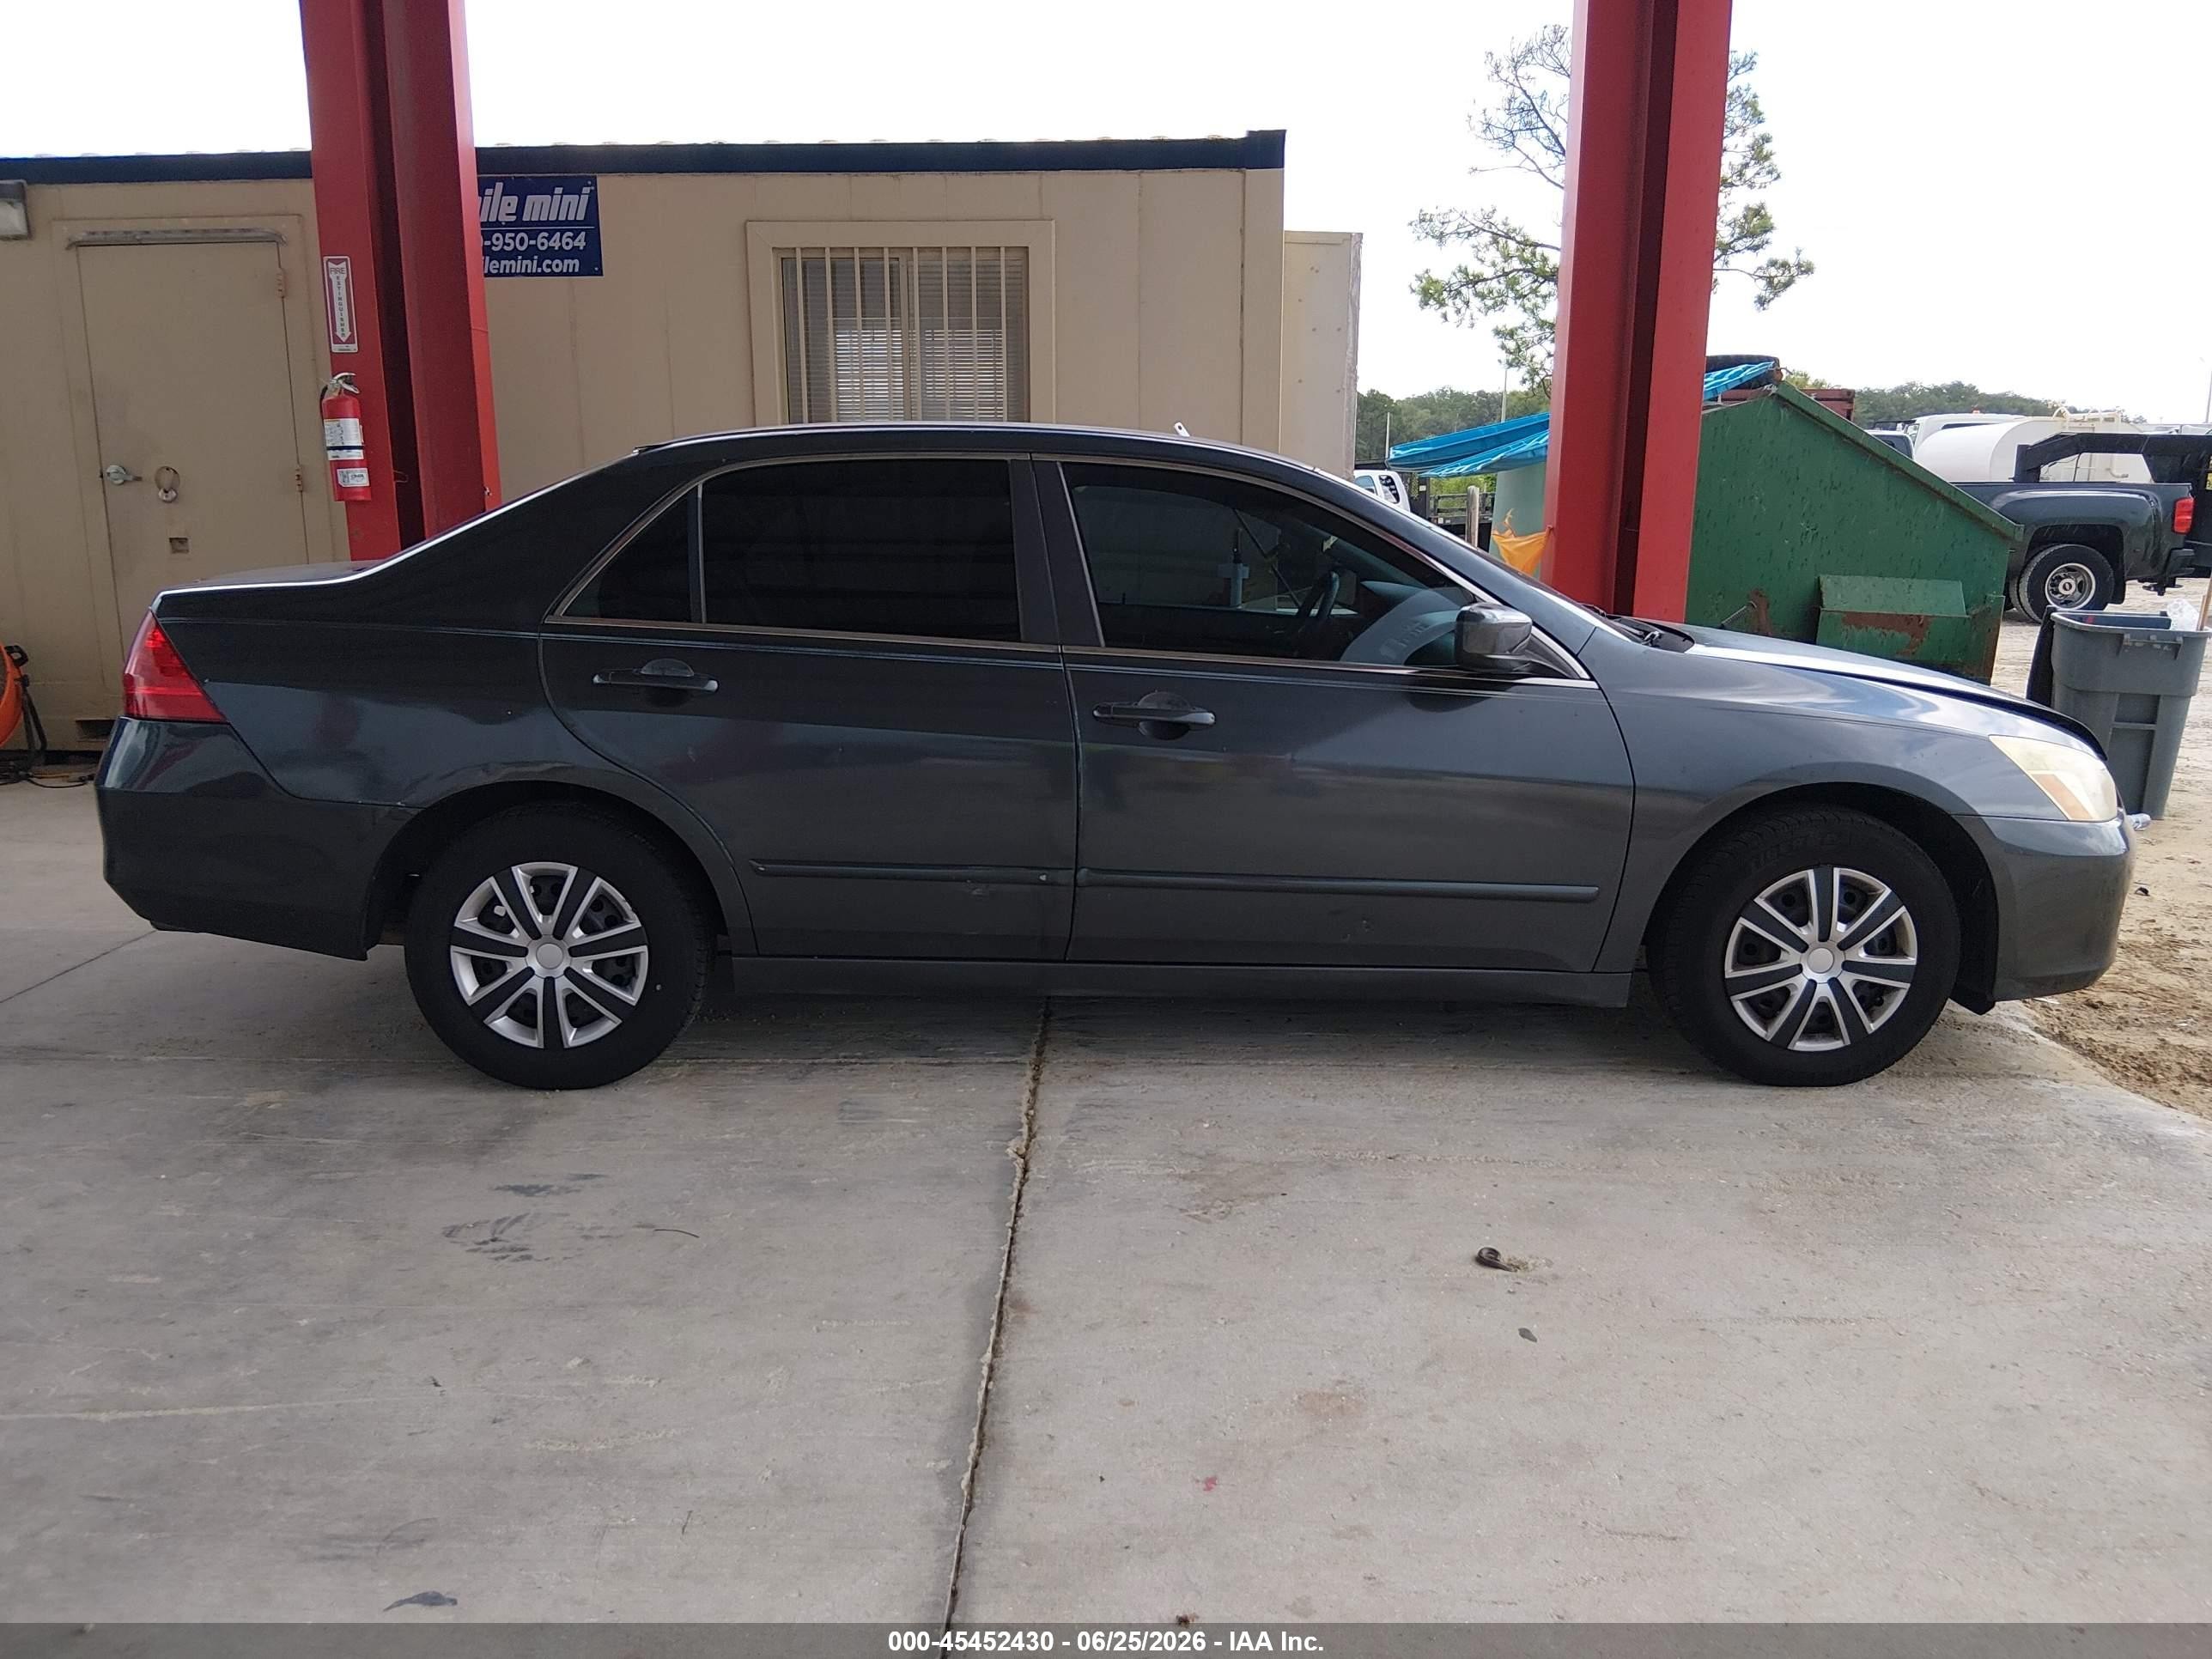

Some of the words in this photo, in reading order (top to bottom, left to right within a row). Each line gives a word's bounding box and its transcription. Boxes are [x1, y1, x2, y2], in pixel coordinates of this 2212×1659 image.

[479, 182, 518, 222] ile
[522, 186, 591, 222] mini
[481, 232, 586, 252] -950-6464
[330, 267, 346, 276] FIRE
[483, 256, 580, 274] lemini.com
[336, 276, 346, 337] EXTINGUISHER
